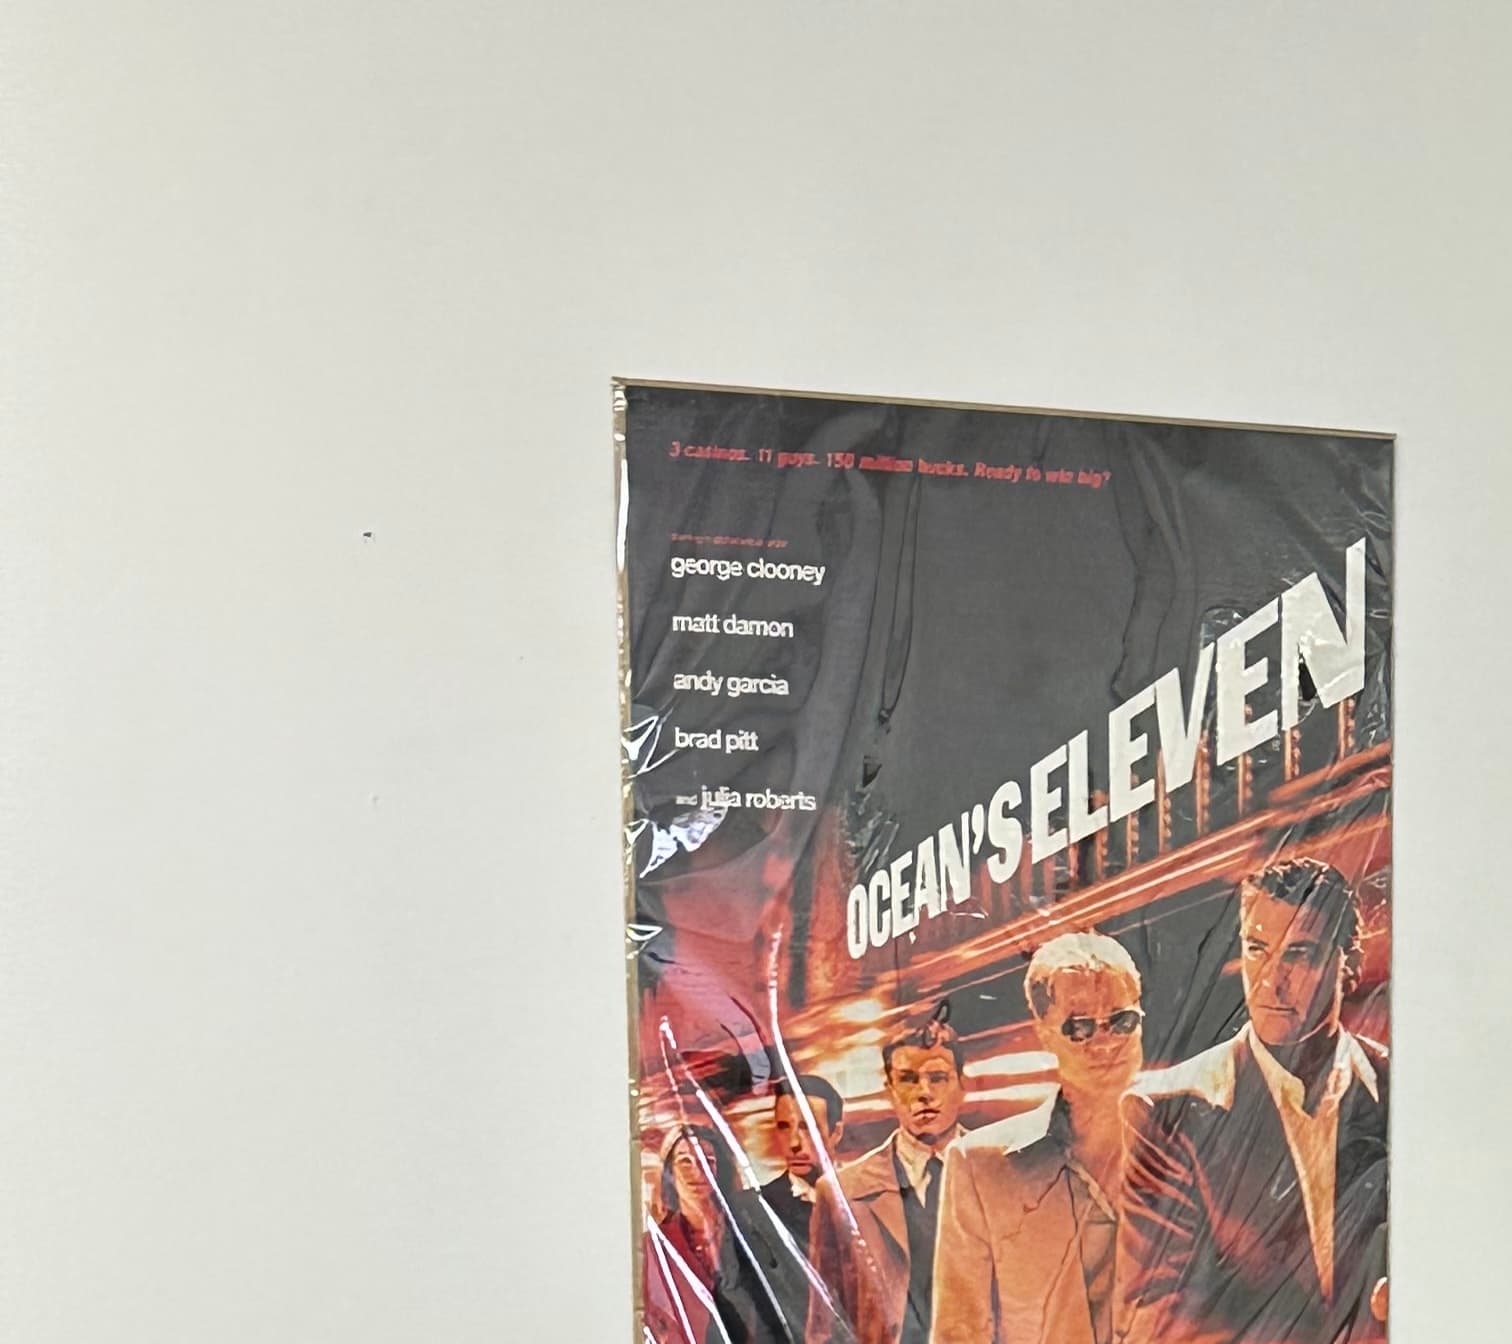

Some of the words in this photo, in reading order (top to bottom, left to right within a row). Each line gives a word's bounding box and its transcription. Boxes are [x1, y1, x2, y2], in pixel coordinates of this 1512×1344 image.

[669, 440, 681, 458] 3
[826, 451, 856, 469] 150
[973, 461, 1023, 484] Ready
[671, 556, 743, 582] george
[746, 557, 827, 587] clooney
[672, 613, 721, 634] matt
[722, 613, 795, 639] damon
[673, 670, 724, 697] andy
[726, 673, 790, 698] garcia
[674, 726, 722, 750] brad
[725, 729, 760, 754] pitt
[846, 780, 1023, 960] OCEAN'S
[1030, 537, 1367, 864] ELEVEN
[745, 787, 817, 811] roberts
